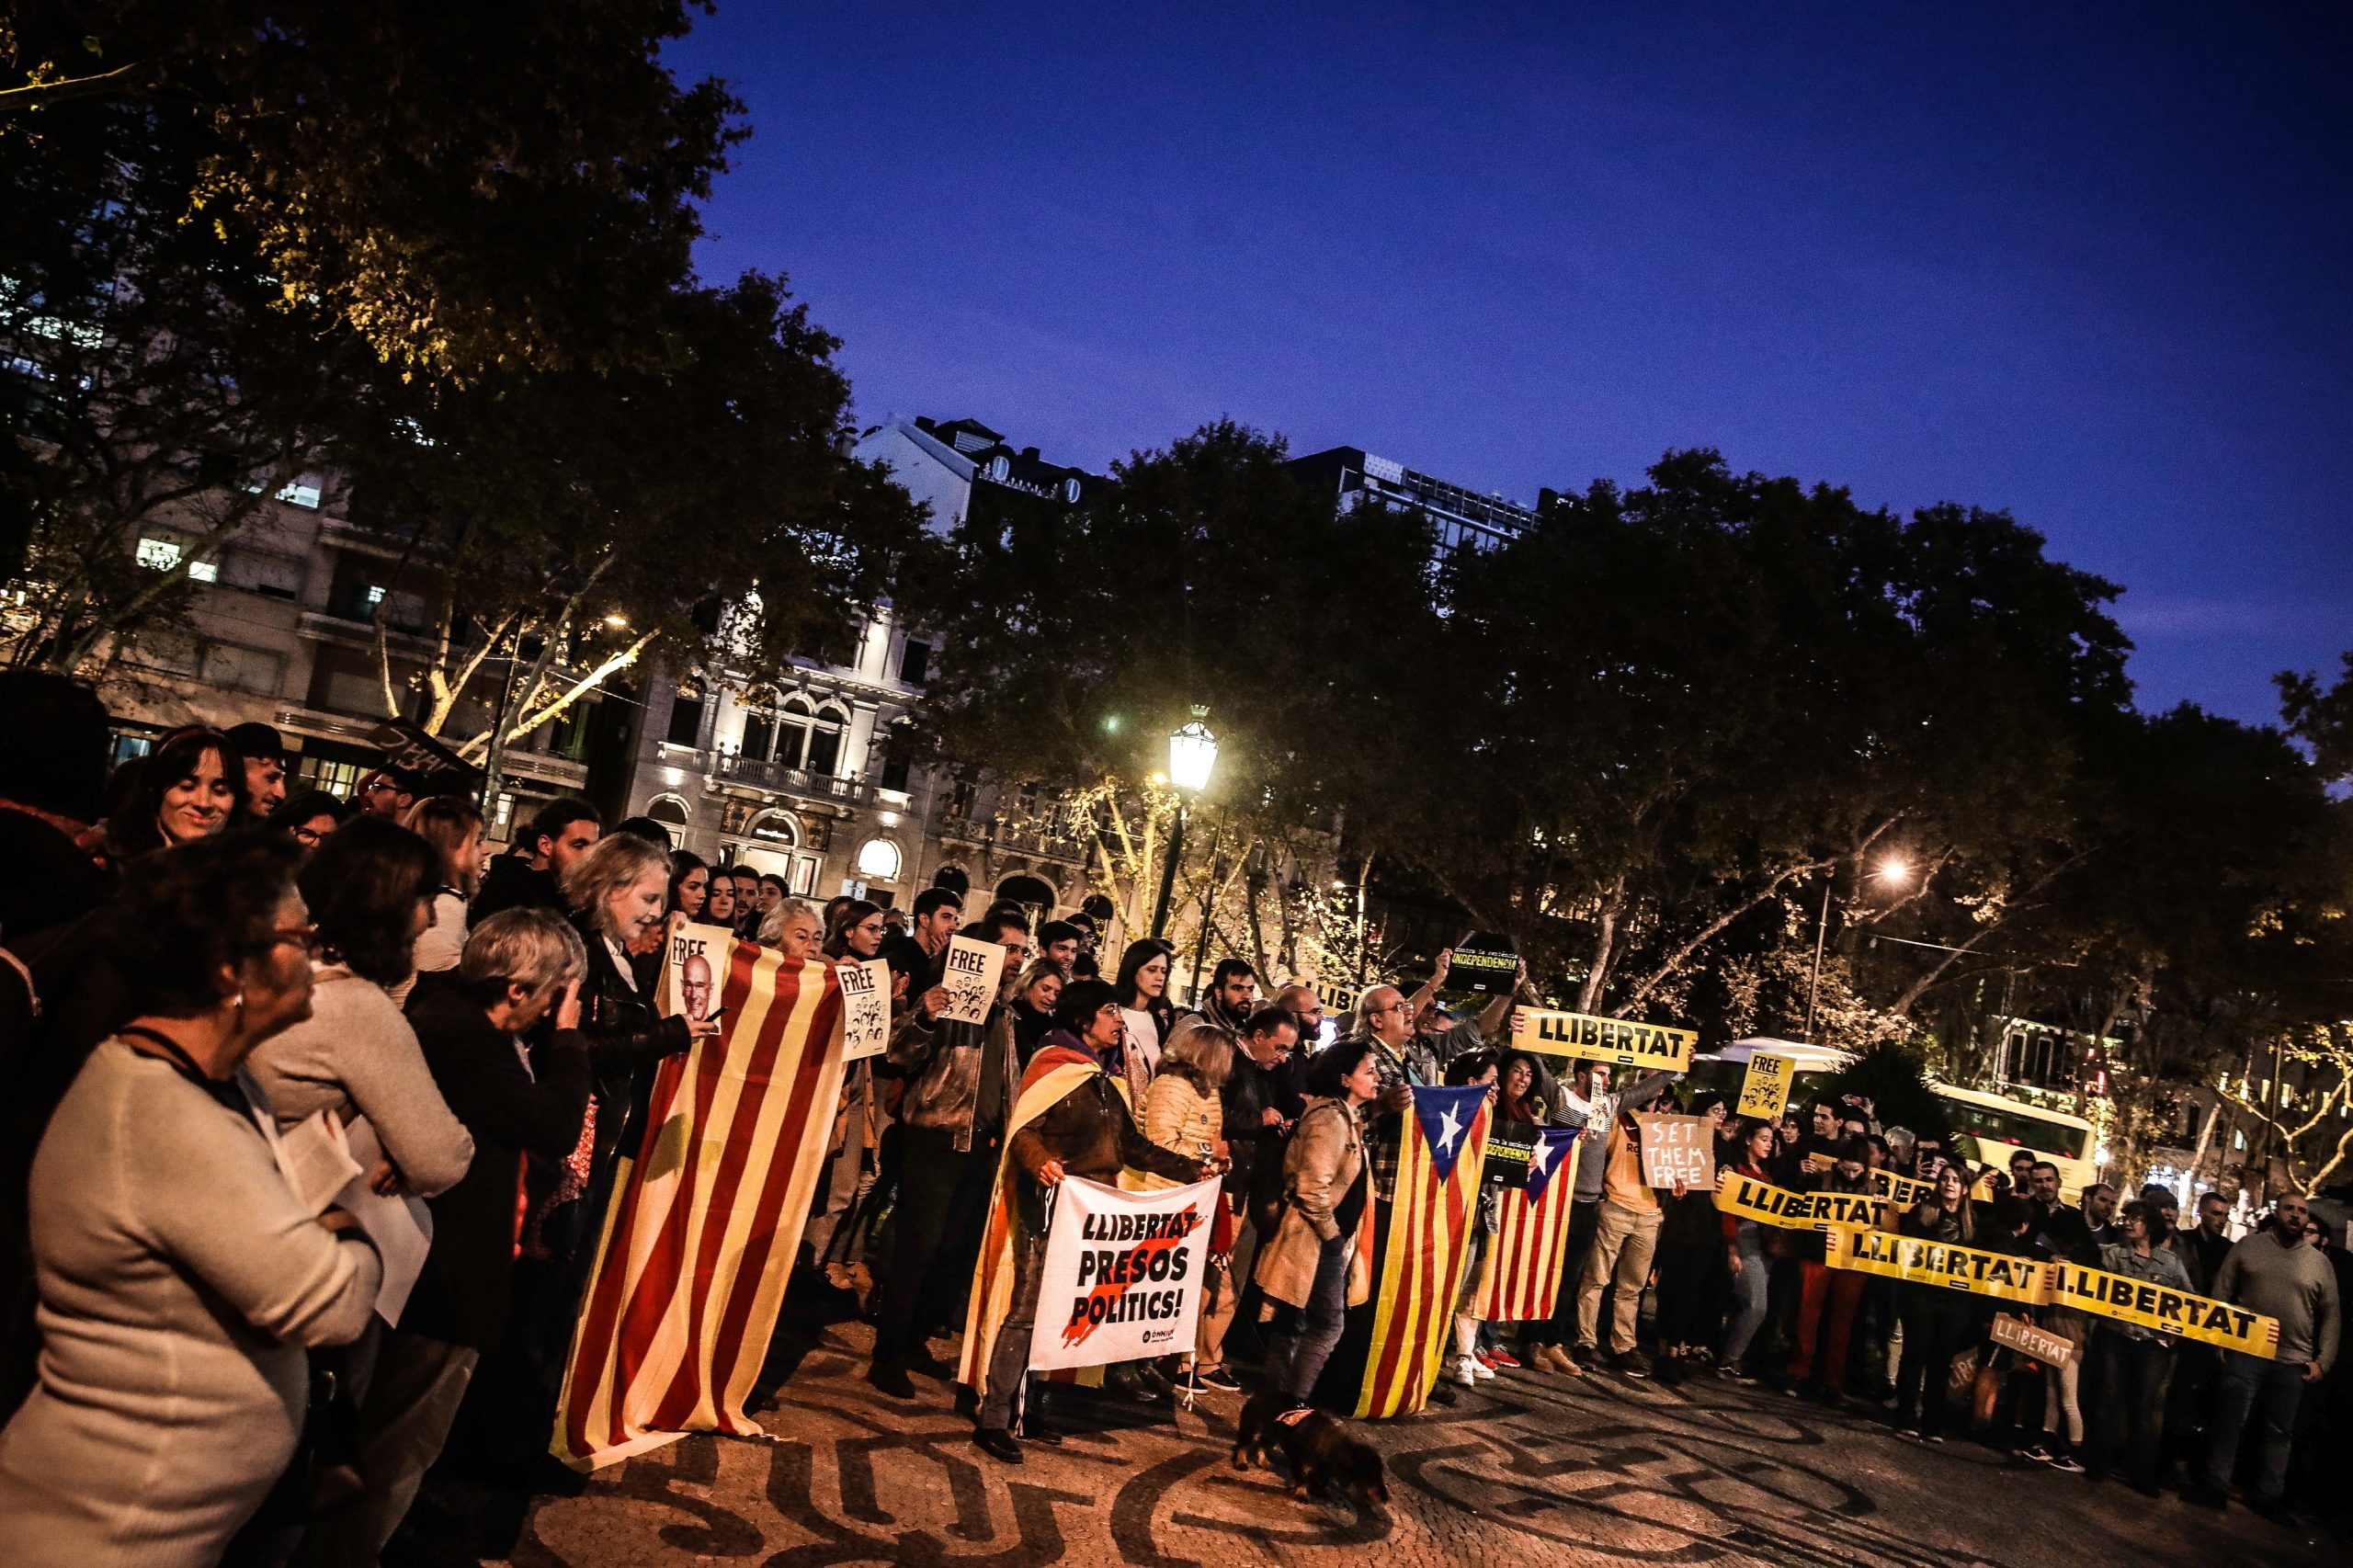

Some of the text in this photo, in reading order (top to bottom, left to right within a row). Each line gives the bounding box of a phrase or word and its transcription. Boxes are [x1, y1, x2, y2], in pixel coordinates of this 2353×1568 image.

[673, 937, 707, 962] FREE
[949, 949, 986, 973] FREE
[840, 968, 875, 992] FREE
[1539, 1017, 1684, 1058] LLIBERTAT
[1752, 1055, 1781, 1074] FREE
[1652, 1120, 1699, 1143] SET
[1647, 1146, 1706, 1166] THEM
[1653, 1165, 1702, 1187] FREE
[1736, 1180, 1889, 1226] LLIBERTAT
[1081, 1211, 1198, 1243] LLIBERTAT
[1077, 1246, 1189, 1287] PRESOS
[1853, 1233, 2035, 1290] LLIBERTAT
[2055, 1265, 2256, 1339] LLIBERTAT
